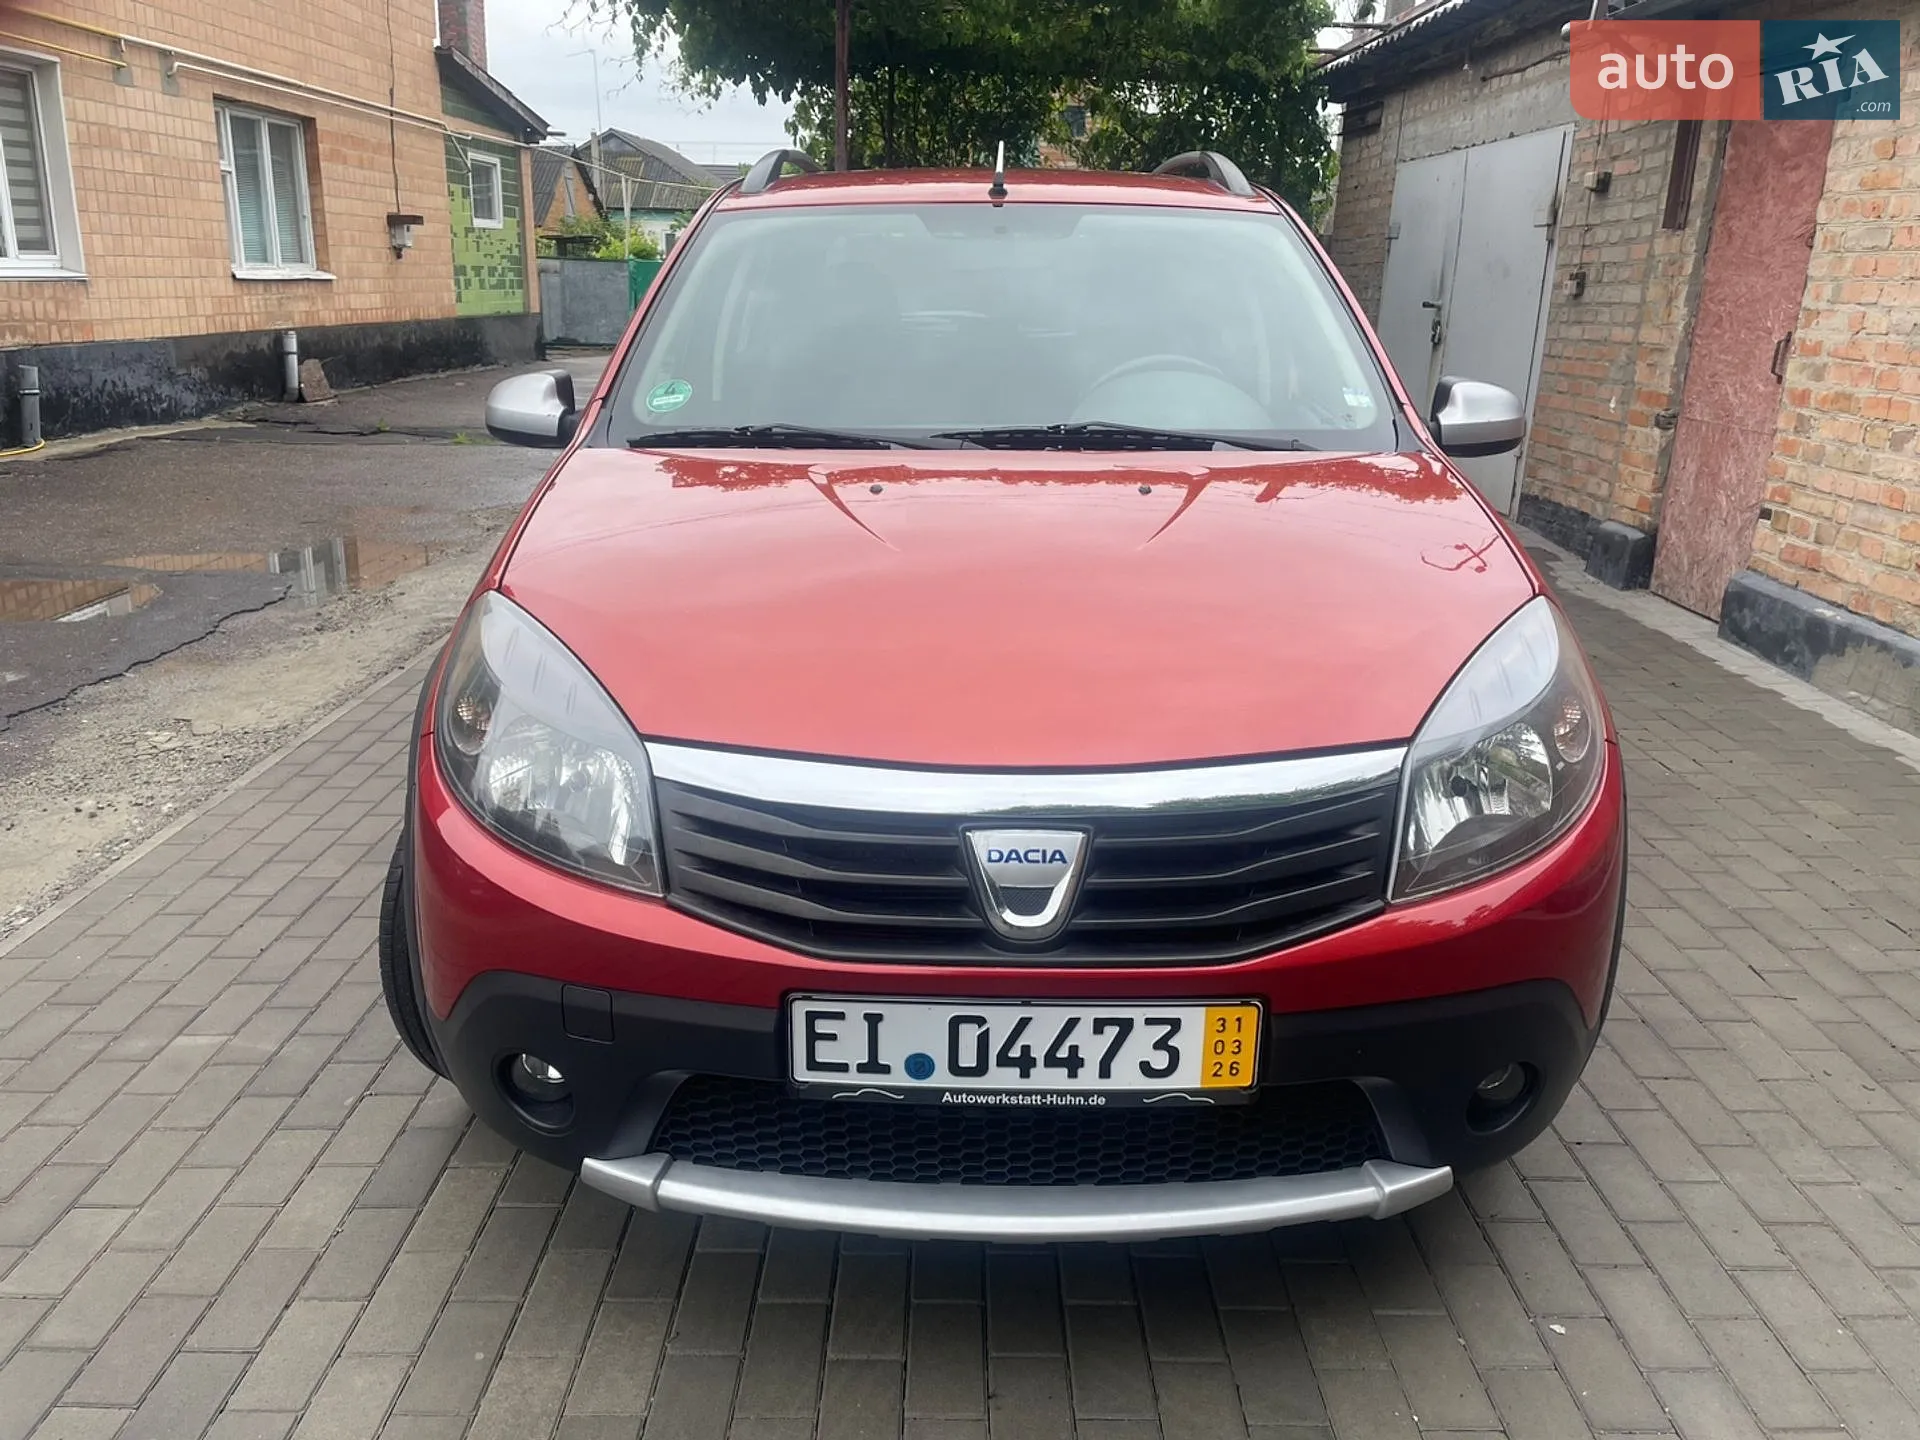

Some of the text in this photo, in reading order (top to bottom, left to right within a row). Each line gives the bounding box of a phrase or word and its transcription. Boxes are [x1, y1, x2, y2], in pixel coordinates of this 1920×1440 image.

[987, 849, 1067, 863] DACIA
[1215, 1016, 1243, 1034] 31
[805, 1010, 1182, 1079] EI 04473
[1213, 1038, 1243, 1056] 03
[1212, 1060, 1242, 1078] 26
[941, 1091, 1107, 1106] Autowerkstatt-Huhn.de
